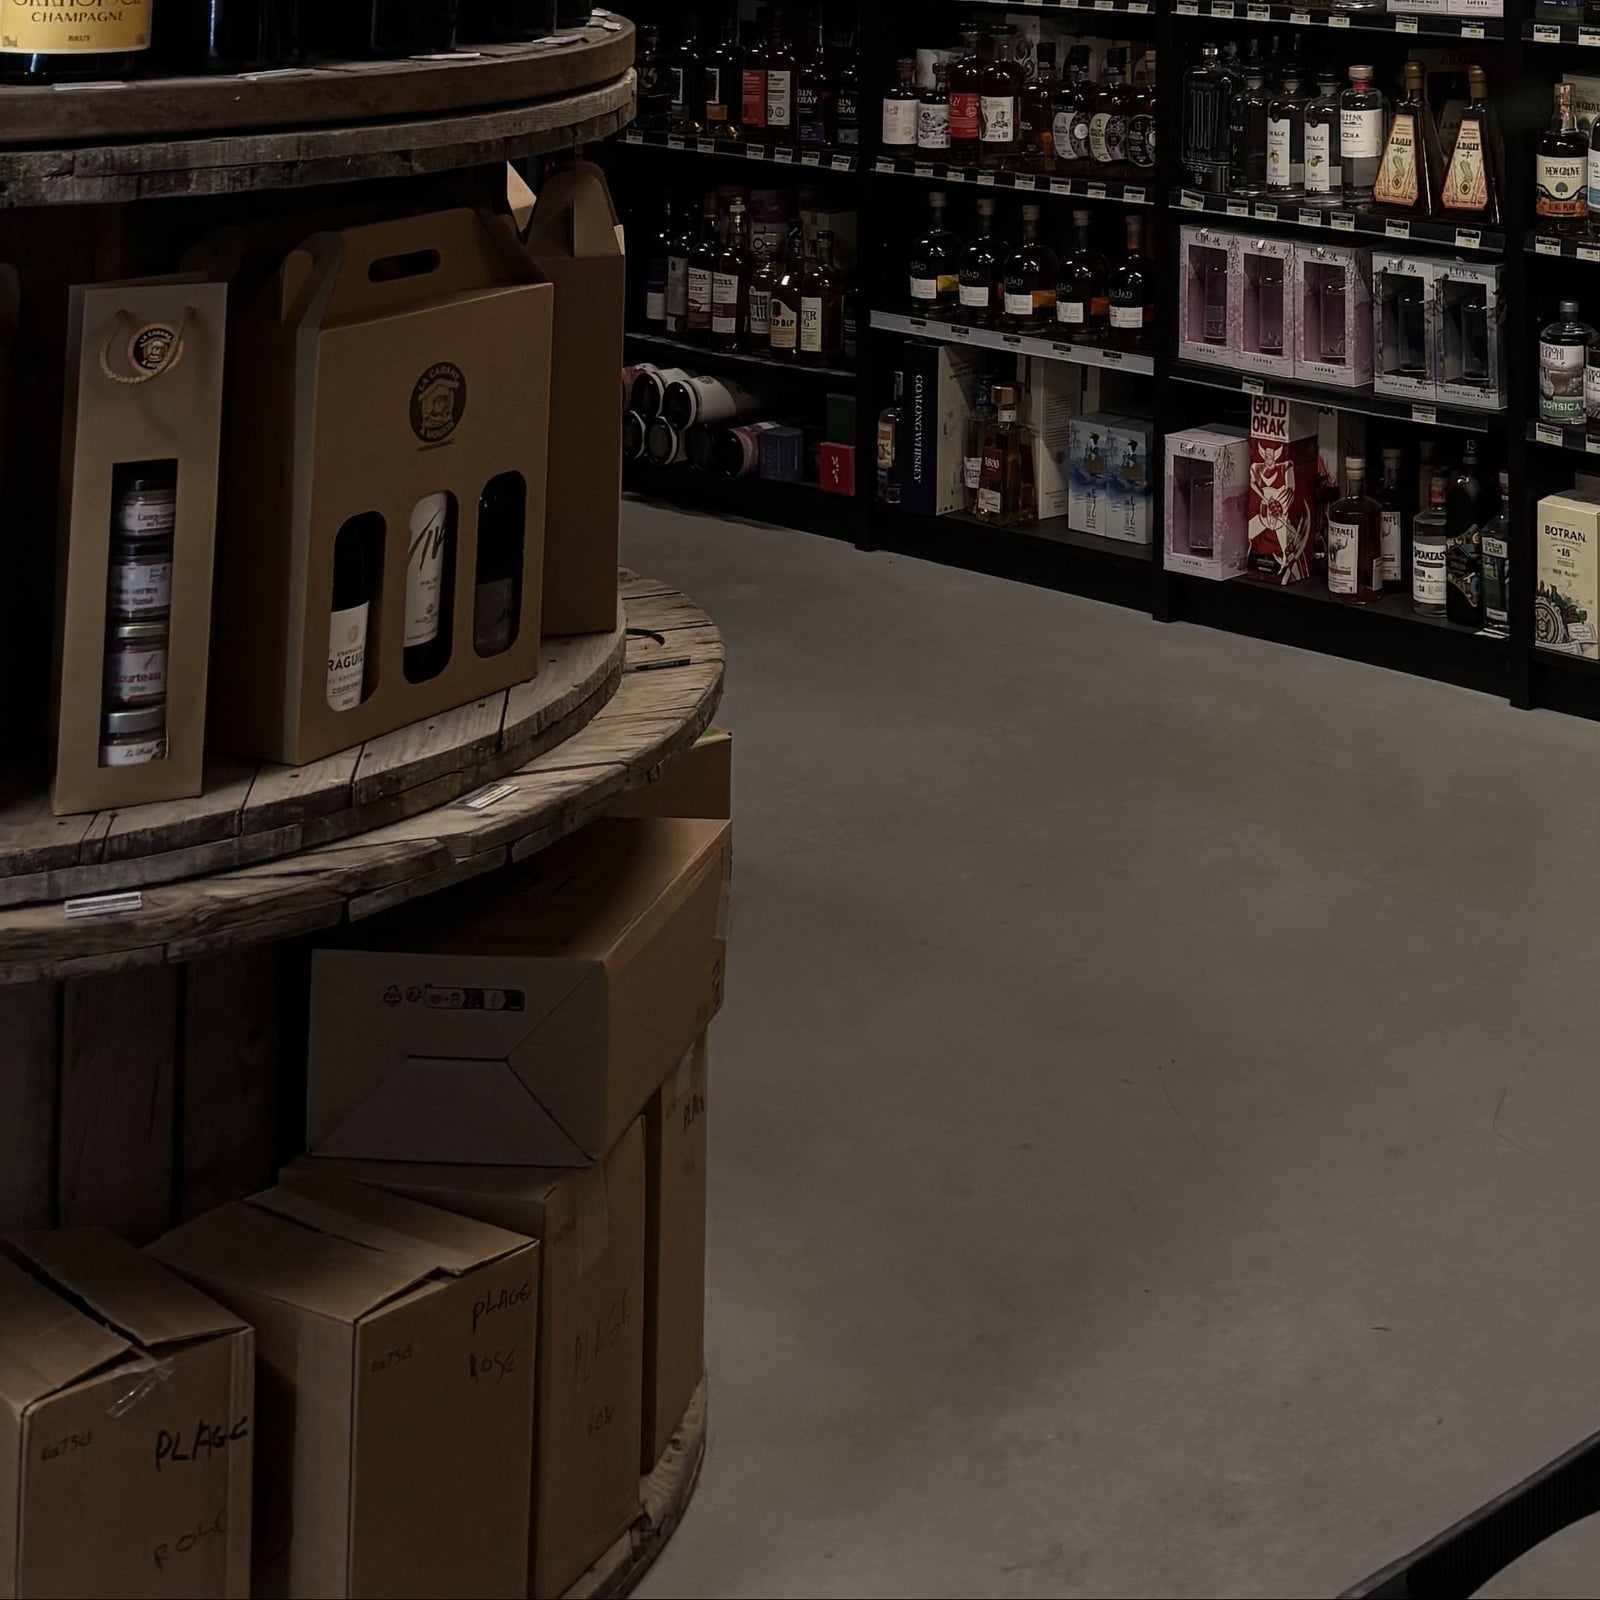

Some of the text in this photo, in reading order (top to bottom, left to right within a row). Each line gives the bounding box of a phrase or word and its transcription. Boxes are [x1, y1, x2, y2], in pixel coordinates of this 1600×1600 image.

[31, 11, 124, 23] CHAMPAGNE
[1253, 397, 1287, 418] GOLD
[1543, 401, 1581, 413] CORSICA
[1252, 414, 1286, 437] ORAK
[1544, 525, 1587, 542] BOTRAN
[472, 1282, 530, 1333] PLAGE
[154, 1415, 248, 1473] PLAGE
